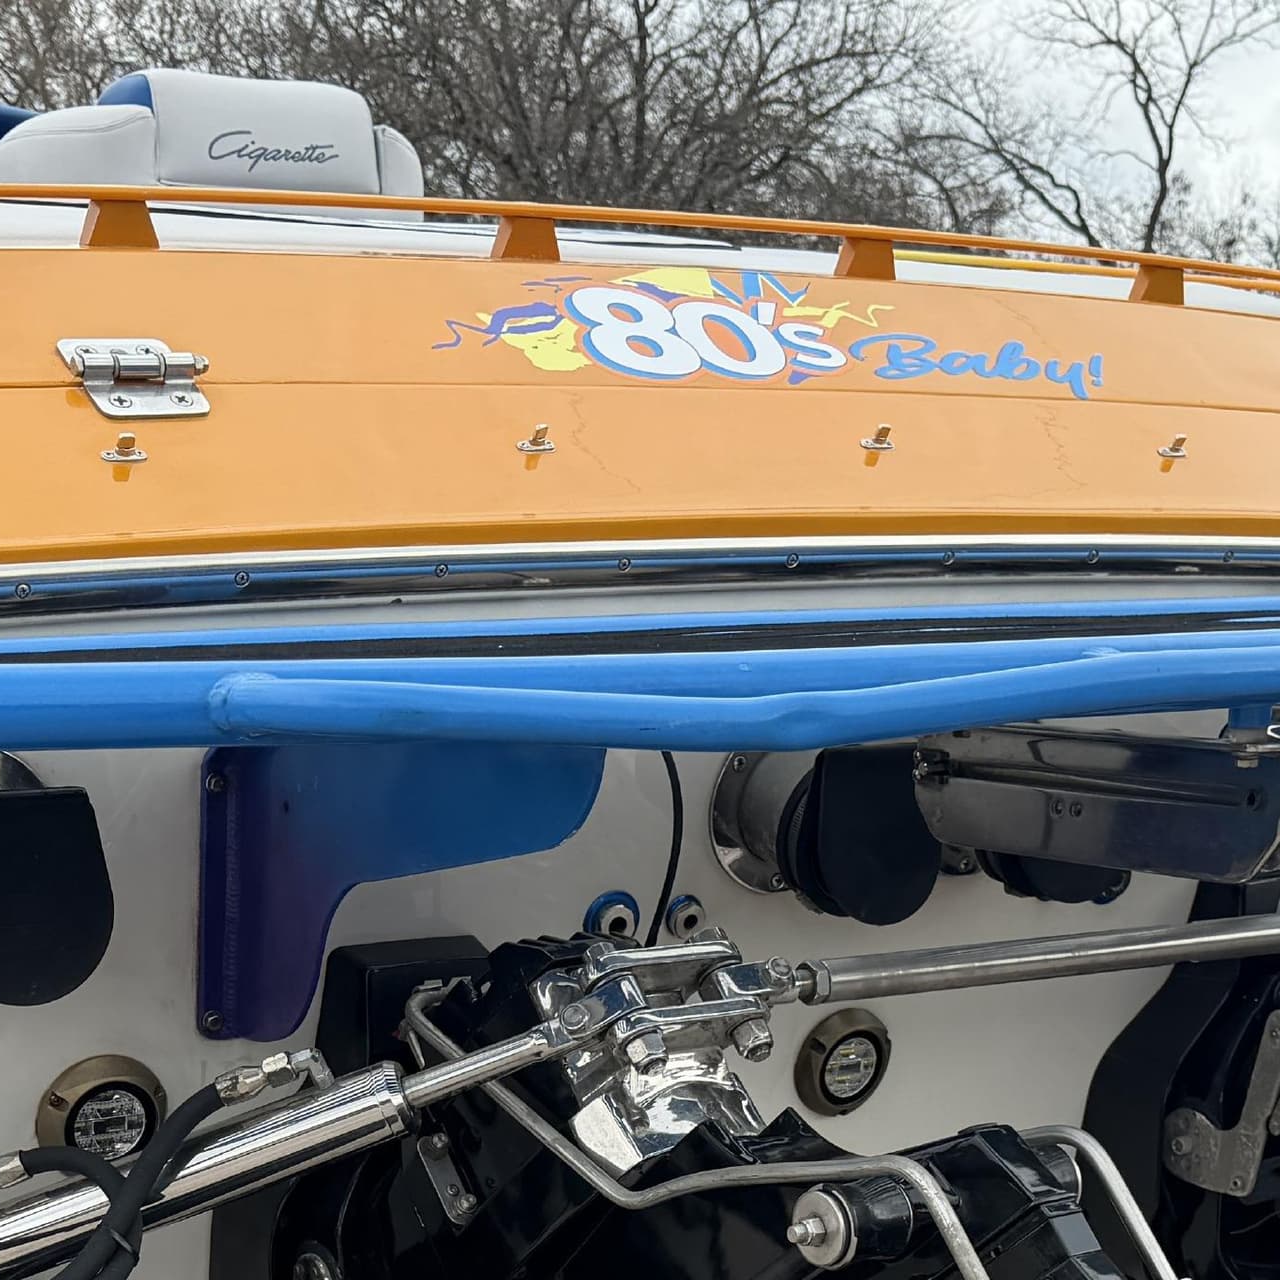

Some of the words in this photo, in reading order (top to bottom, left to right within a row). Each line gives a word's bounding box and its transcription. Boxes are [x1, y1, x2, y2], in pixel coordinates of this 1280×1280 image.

[208, 130, 340, 173] Cigarette
[568, 284, 850, 380] 80's
[849, 332, 1104, 400] Baby!
